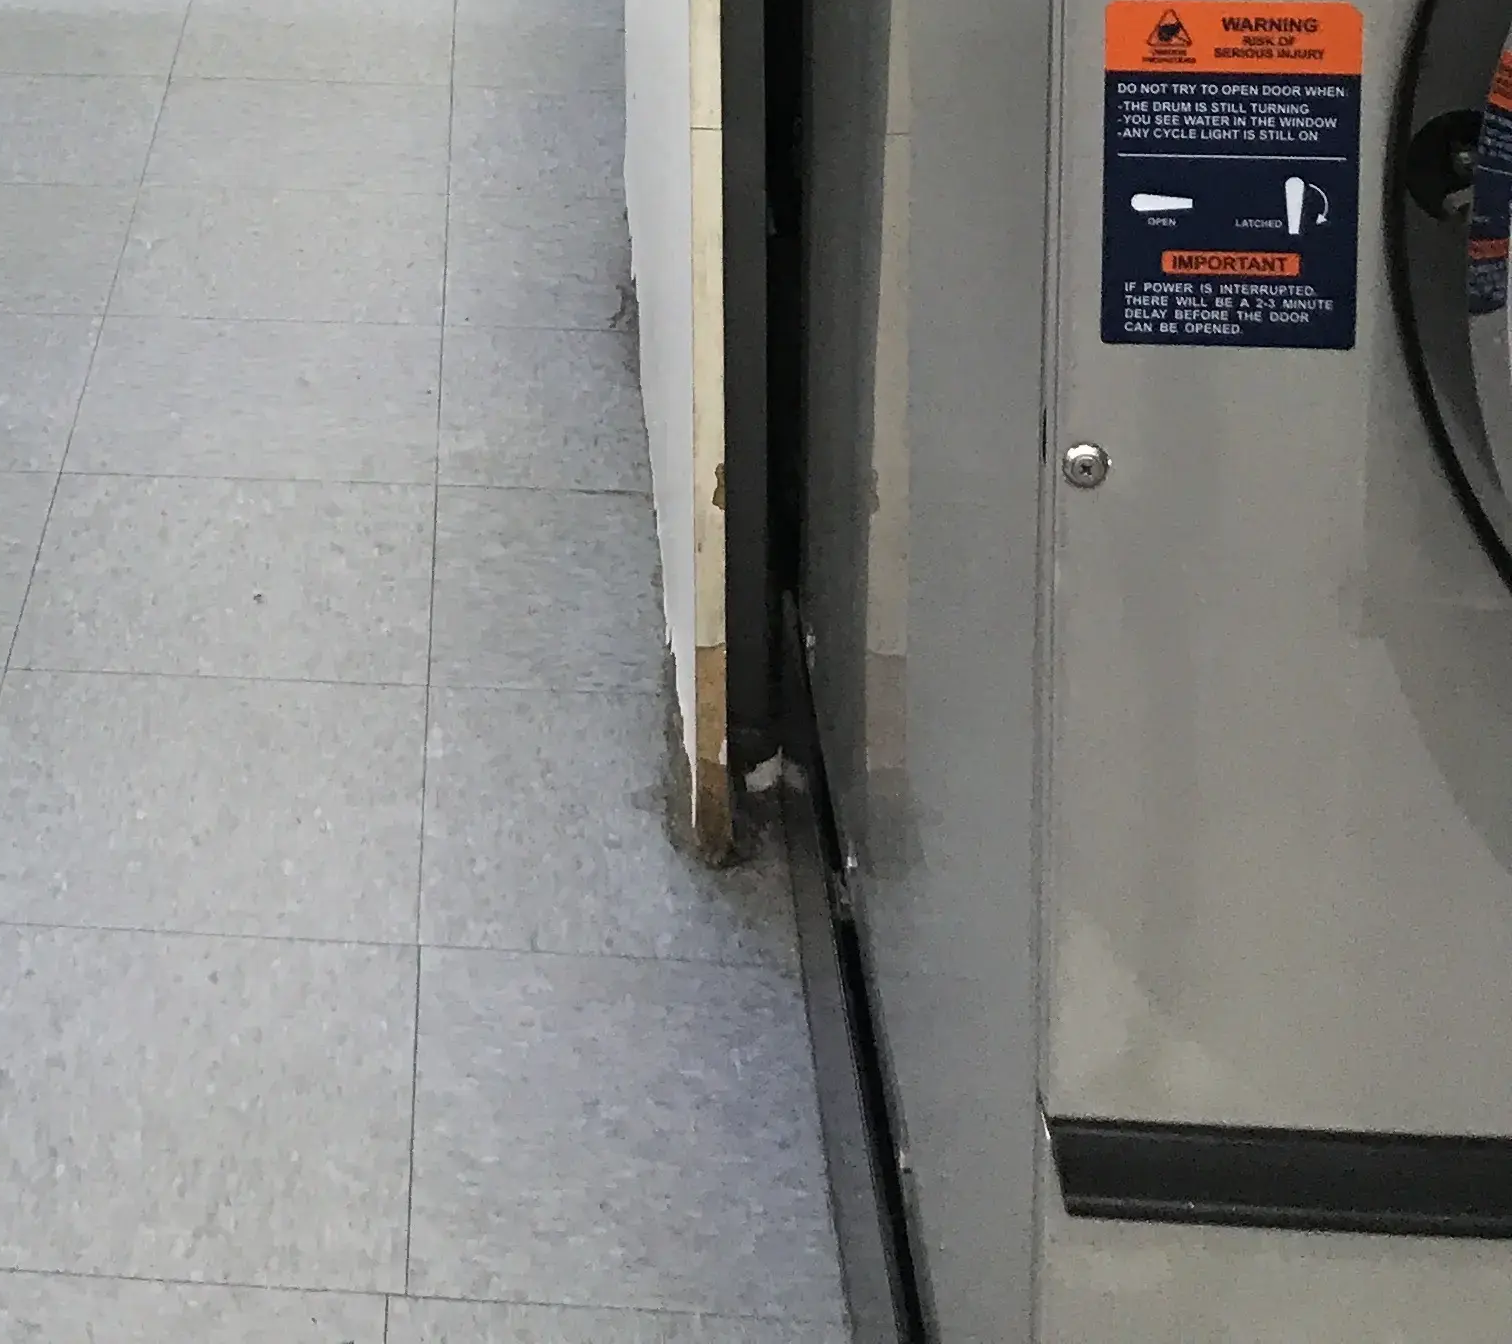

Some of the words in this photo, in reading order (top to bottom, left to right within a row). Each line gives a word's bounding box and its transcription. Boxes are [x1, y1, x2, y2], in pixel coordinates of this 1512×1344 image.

[1222, 17, 1318, 32] WARNING
[1242, 36, 1276, 46] RISK
[1279, 36, 1295, 46] OF
[1214, 47, 1273, 59] SERIOUS
[1277, 48, 1324, 60] INJURY
[1118, 84, 1137, 94] DO
[1141, 84, 1168, 94] NOT
[1172, 84, 1197, 95] TRY
[1202, 85, 1218, 95] TO
[1222, 85, 1258, 95] OPEN
[1262, 86, 1301, 96] DOOR
[1153, 102, 1191, 112] DRUM
[1195, 102, 1207, 112] IS
[1211, 102, 1246, 113] STILL
[1250, 103, 1310, 114] TURNING
[1154, 115, 1180, 125] SEE
[1184, 116, 1229, 126] WATER
[1233, 116, 1246, 126] IN
[1250, 116, 1275, 127] THE
[1279, 117, 1337, 128] WINDOW
[1153, 128, 1197, 139] CYCLE
[1201, 129, 1239, 140] LIGHT
[1243, 130, 1255, 140] IS
[1259, 130, 1295, 140] STILL
[1298, 131, 1318, 141] ON
[1148, 218, 1176, 226] OPEN
[1236, 219, 1282, 228] LATCHED
[1172, 255, 1287, 271] IMPORTANT
[1125, 282, 1136, 291] IF
[1144, 282, 1193, 293] POWER
[1200, 284, 1212, 293] IS
[1125, 295, 1168, 306] THERE
[1176, 296, 1207, 306] WILL
[1215, 297, 1232, 307] BE
[1240, 298, 1250, 308] A
[1256, 298, 1276, 308] 2-3
[1283, 300, 1334, 310] MINUTE
[1125, 309, 1167, 319] DELAY
[1175, 310, 1228, 321] BEFORE
[1237, 311, 1262, 321] THE
[1270, 312, 1309, 322] DOOR
[1124, 322, 1152, 332] CAN
[1160, 323, 1177, 333] BE
